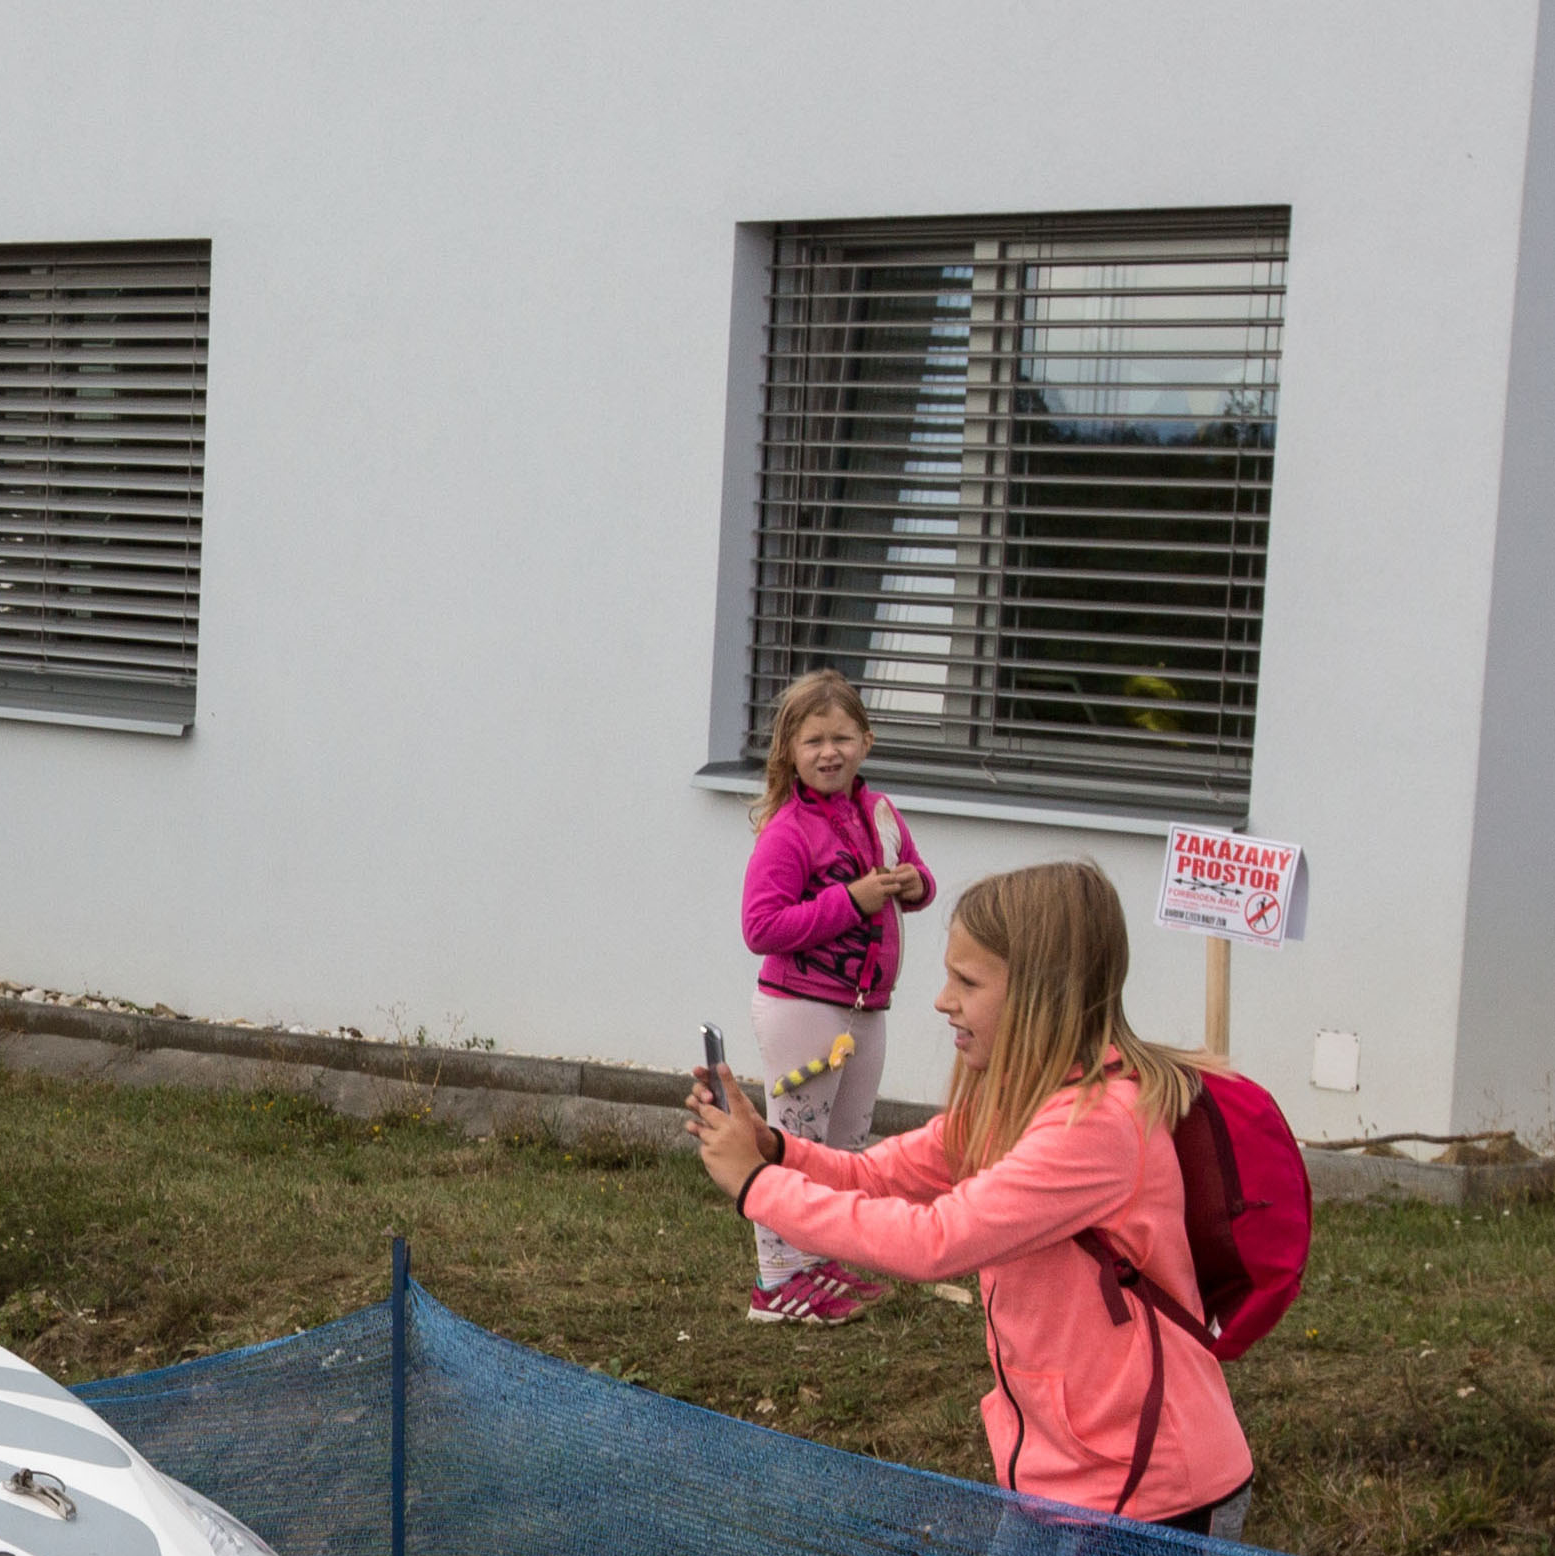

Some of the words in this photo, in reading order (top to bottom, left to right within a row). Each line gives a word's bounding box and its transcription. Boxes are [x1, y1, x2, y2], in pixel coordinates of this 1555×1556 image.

[1175, 832, 1293, 872] ZAKÁZANÝ
[1177, 856, 1281, 892] PROSTOR
[1168, 888, 1216, 904] FORBIDDEN
[1218, 896, 1241, 909] AREA
